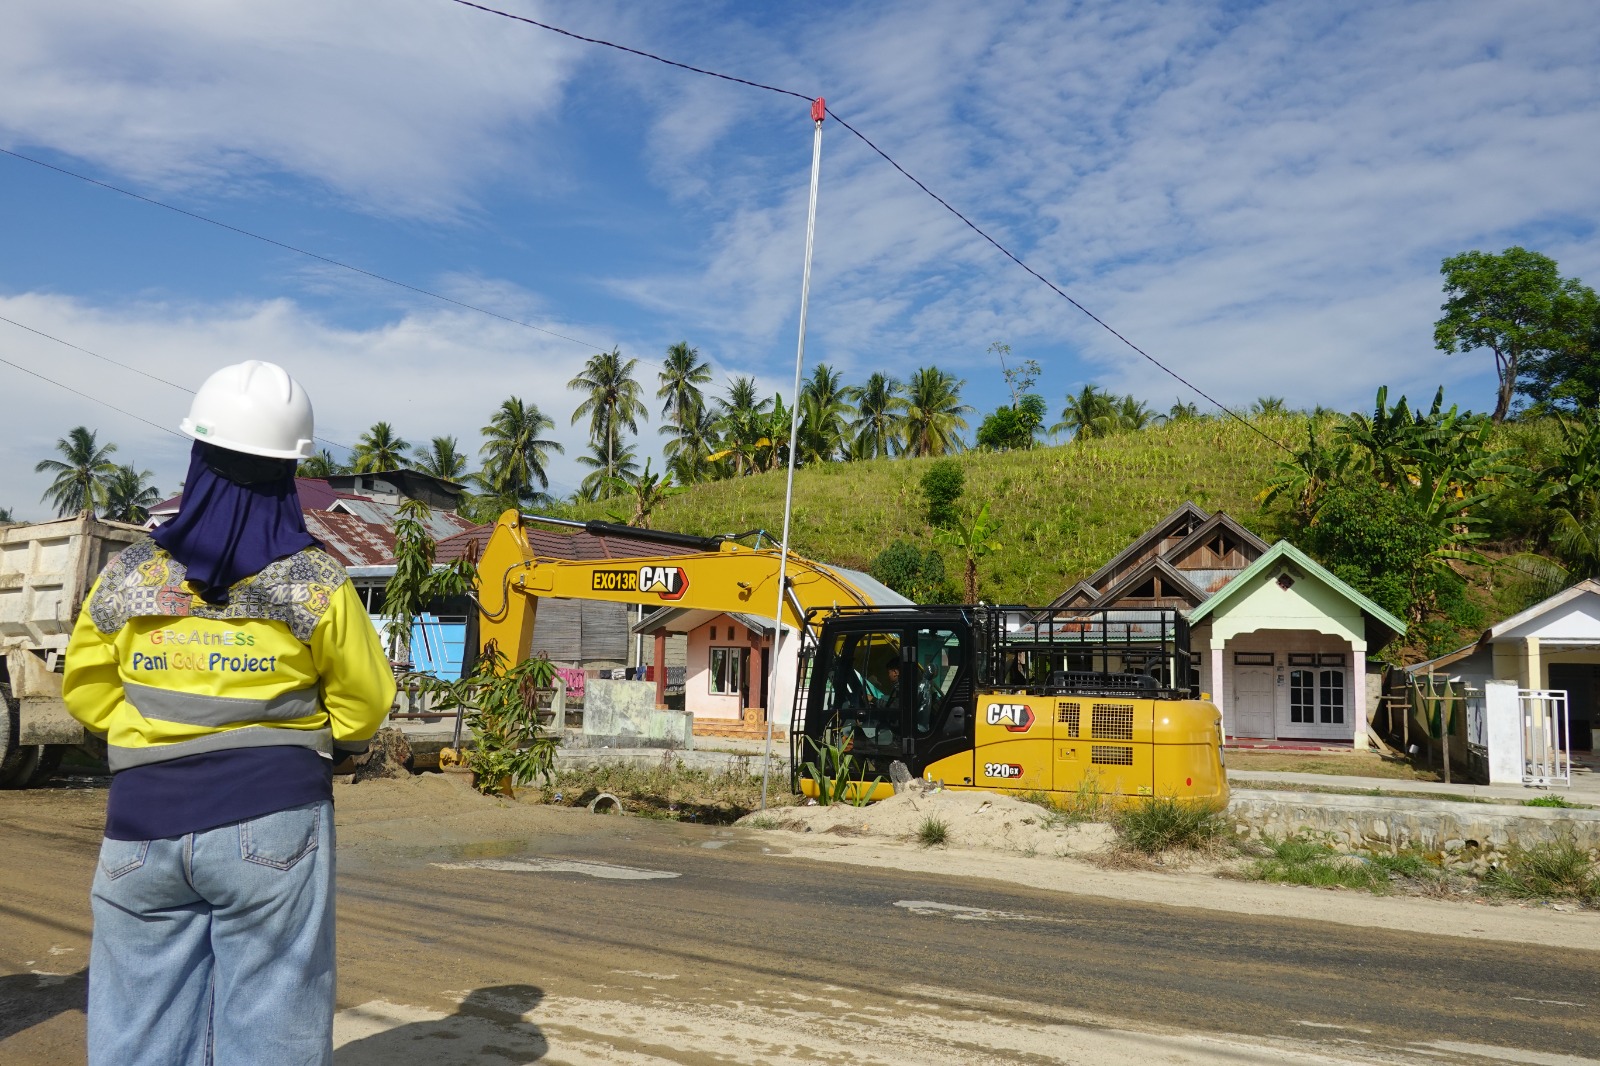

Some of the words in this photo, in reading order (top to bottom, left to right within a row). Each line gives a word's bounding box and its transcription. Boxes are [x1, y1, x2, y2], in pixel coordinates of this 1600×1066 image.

[640, 566, 678, 592] CAT
[133, 652, 168, 670] Pani
[171, 652, 205, 671] Gold
[209, 653, 276, 672] Project
[987, 704, 1025, 725] CAT
